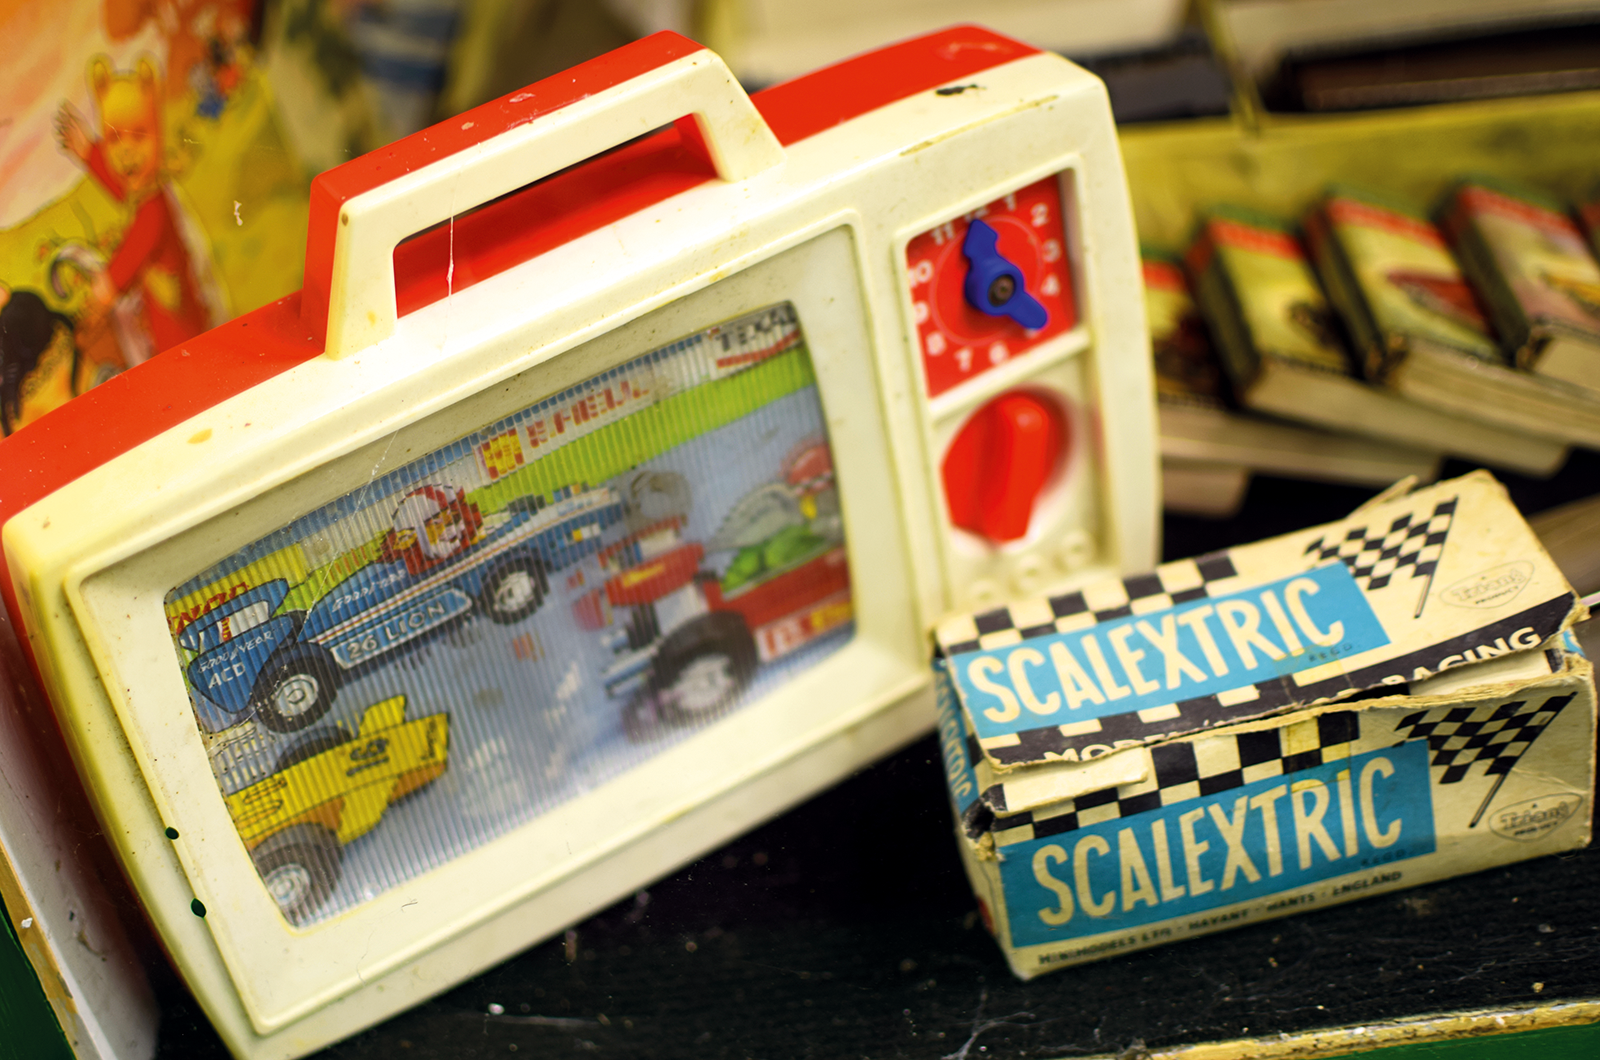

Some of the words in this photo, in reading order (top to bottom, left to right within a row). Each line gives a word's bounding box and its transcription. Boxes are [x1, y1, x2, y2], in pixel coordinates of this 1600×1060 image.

[1030, 203, 1048, 227] 2
[347, 634, 377, 660] 26
[385, 600, 446, 641] LION
[967, 576, 1345, 723] SCALEXTRIC
[208, 661, 246, 689] ACD
[1031, 756, 1403, 926] SCALEXTRIC
[1332, 870, 1403, 896] ENGLAND
